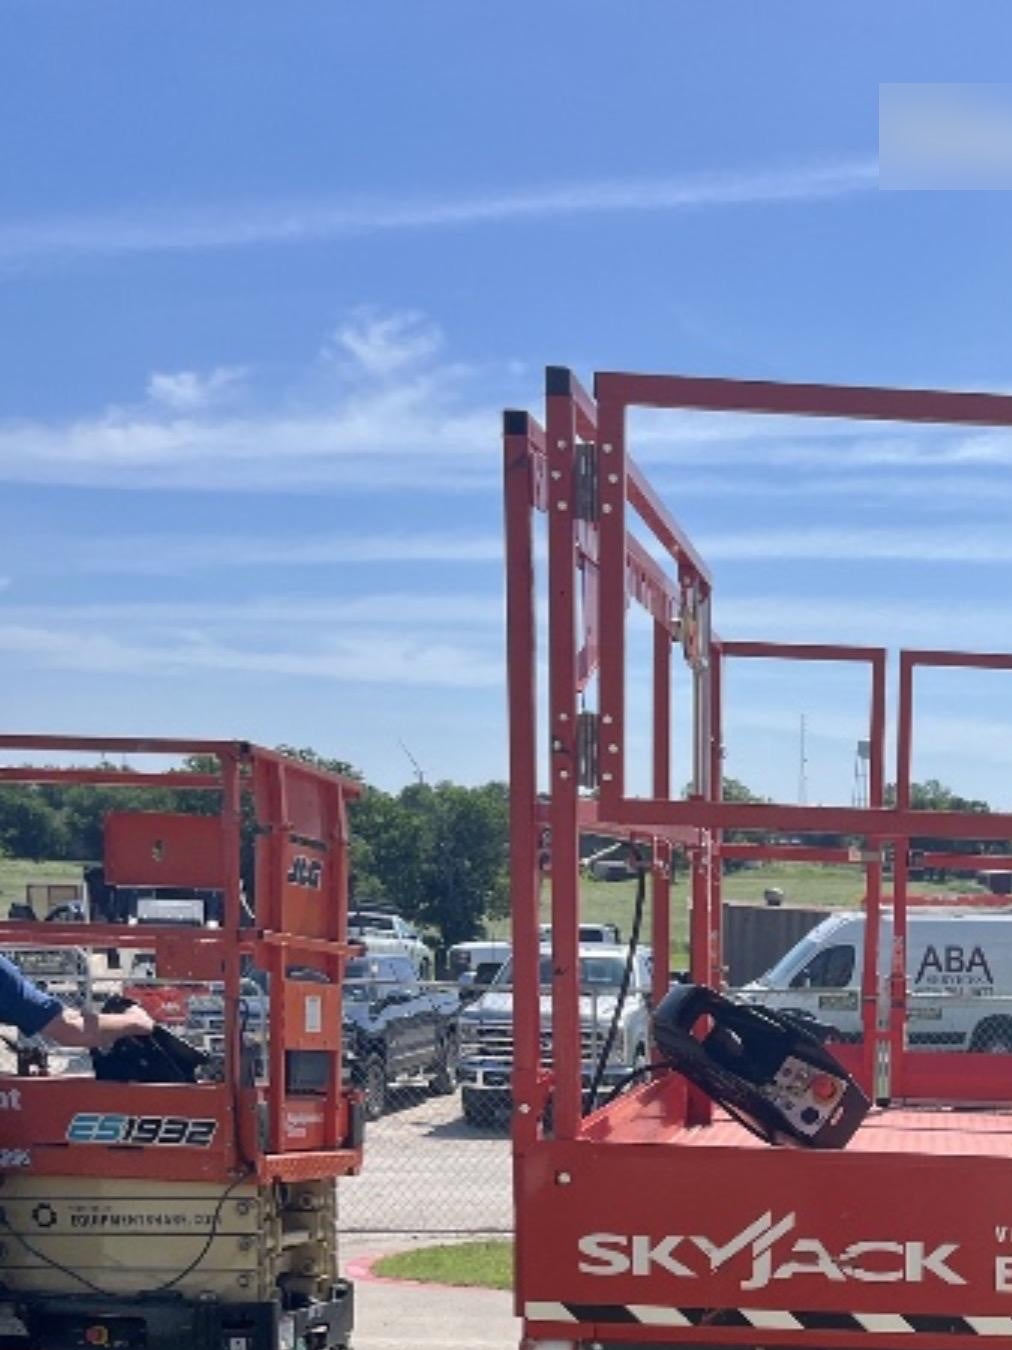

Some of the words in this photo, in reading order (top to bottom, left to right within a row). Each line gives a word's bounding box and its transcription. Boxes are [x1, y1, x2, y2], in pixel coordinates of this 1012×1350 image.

[914, 944, 994, 985] ABA
[66, 1112, 219, 1149] ES1932
[577, 1210, 968, 1291] SKYJACK
